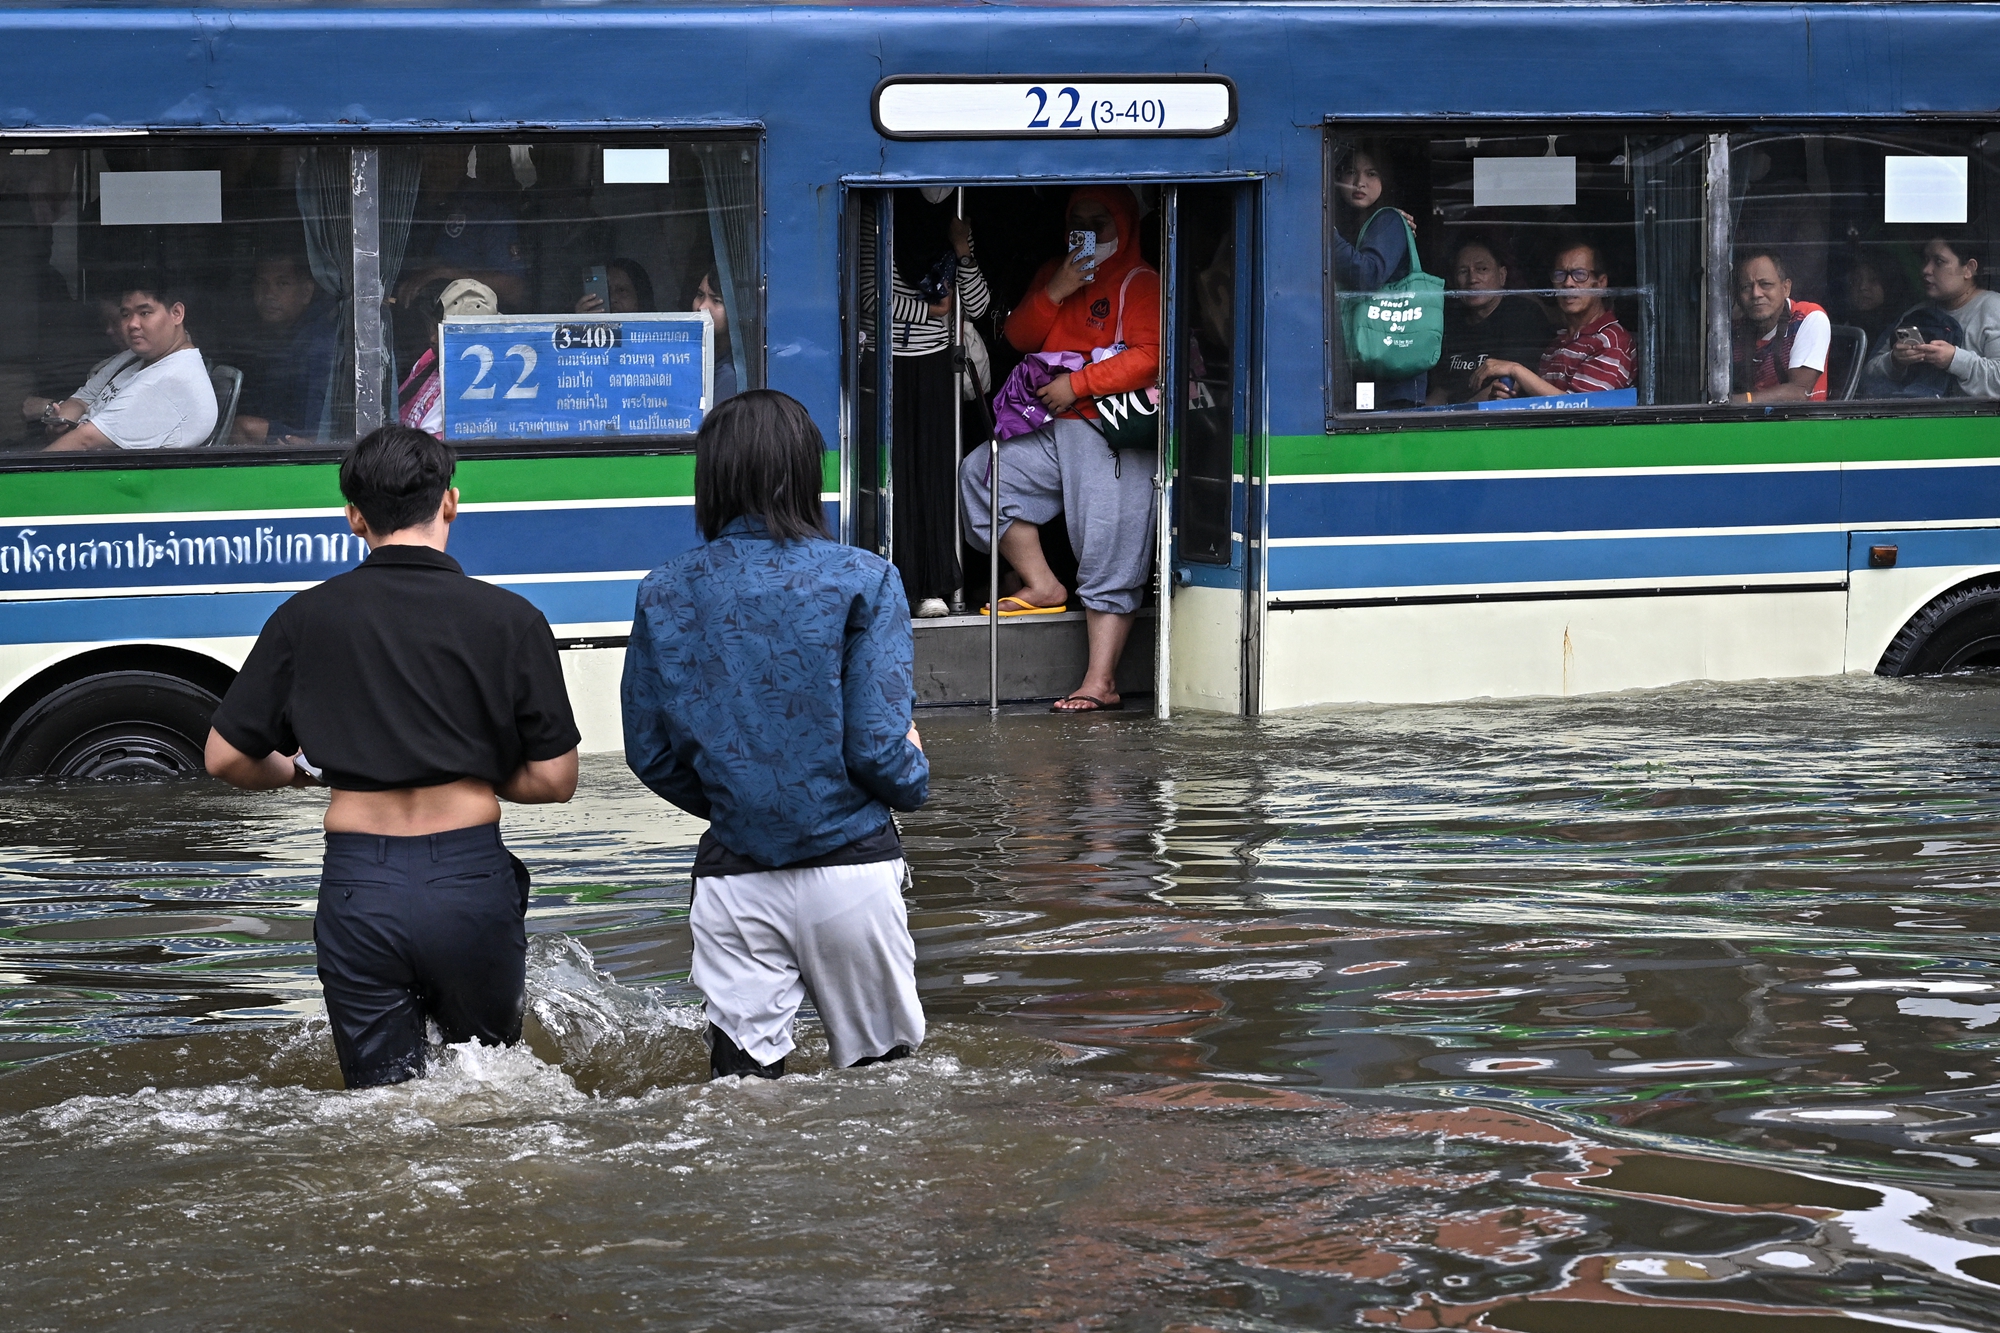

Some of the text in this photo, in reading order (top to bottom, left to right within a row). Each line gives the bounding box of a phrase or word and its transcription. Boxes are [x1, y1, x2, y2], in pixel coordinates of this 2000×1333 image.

[1025, 86, 1165, 128] 22 (3-40)
[1367, 305, 1422, 322] Beans
[551, 326, 615, 352] (3-40)
[619, 352, 655, 367] สวนพลู
[662, 352, 691, 365] สาทร
[459, 344, 540, 399] 22
[557, 370, 672, 388] บ่อนไก่ ตลาดคลองเตย
[622, 393, 668, 409] พระโขนง
